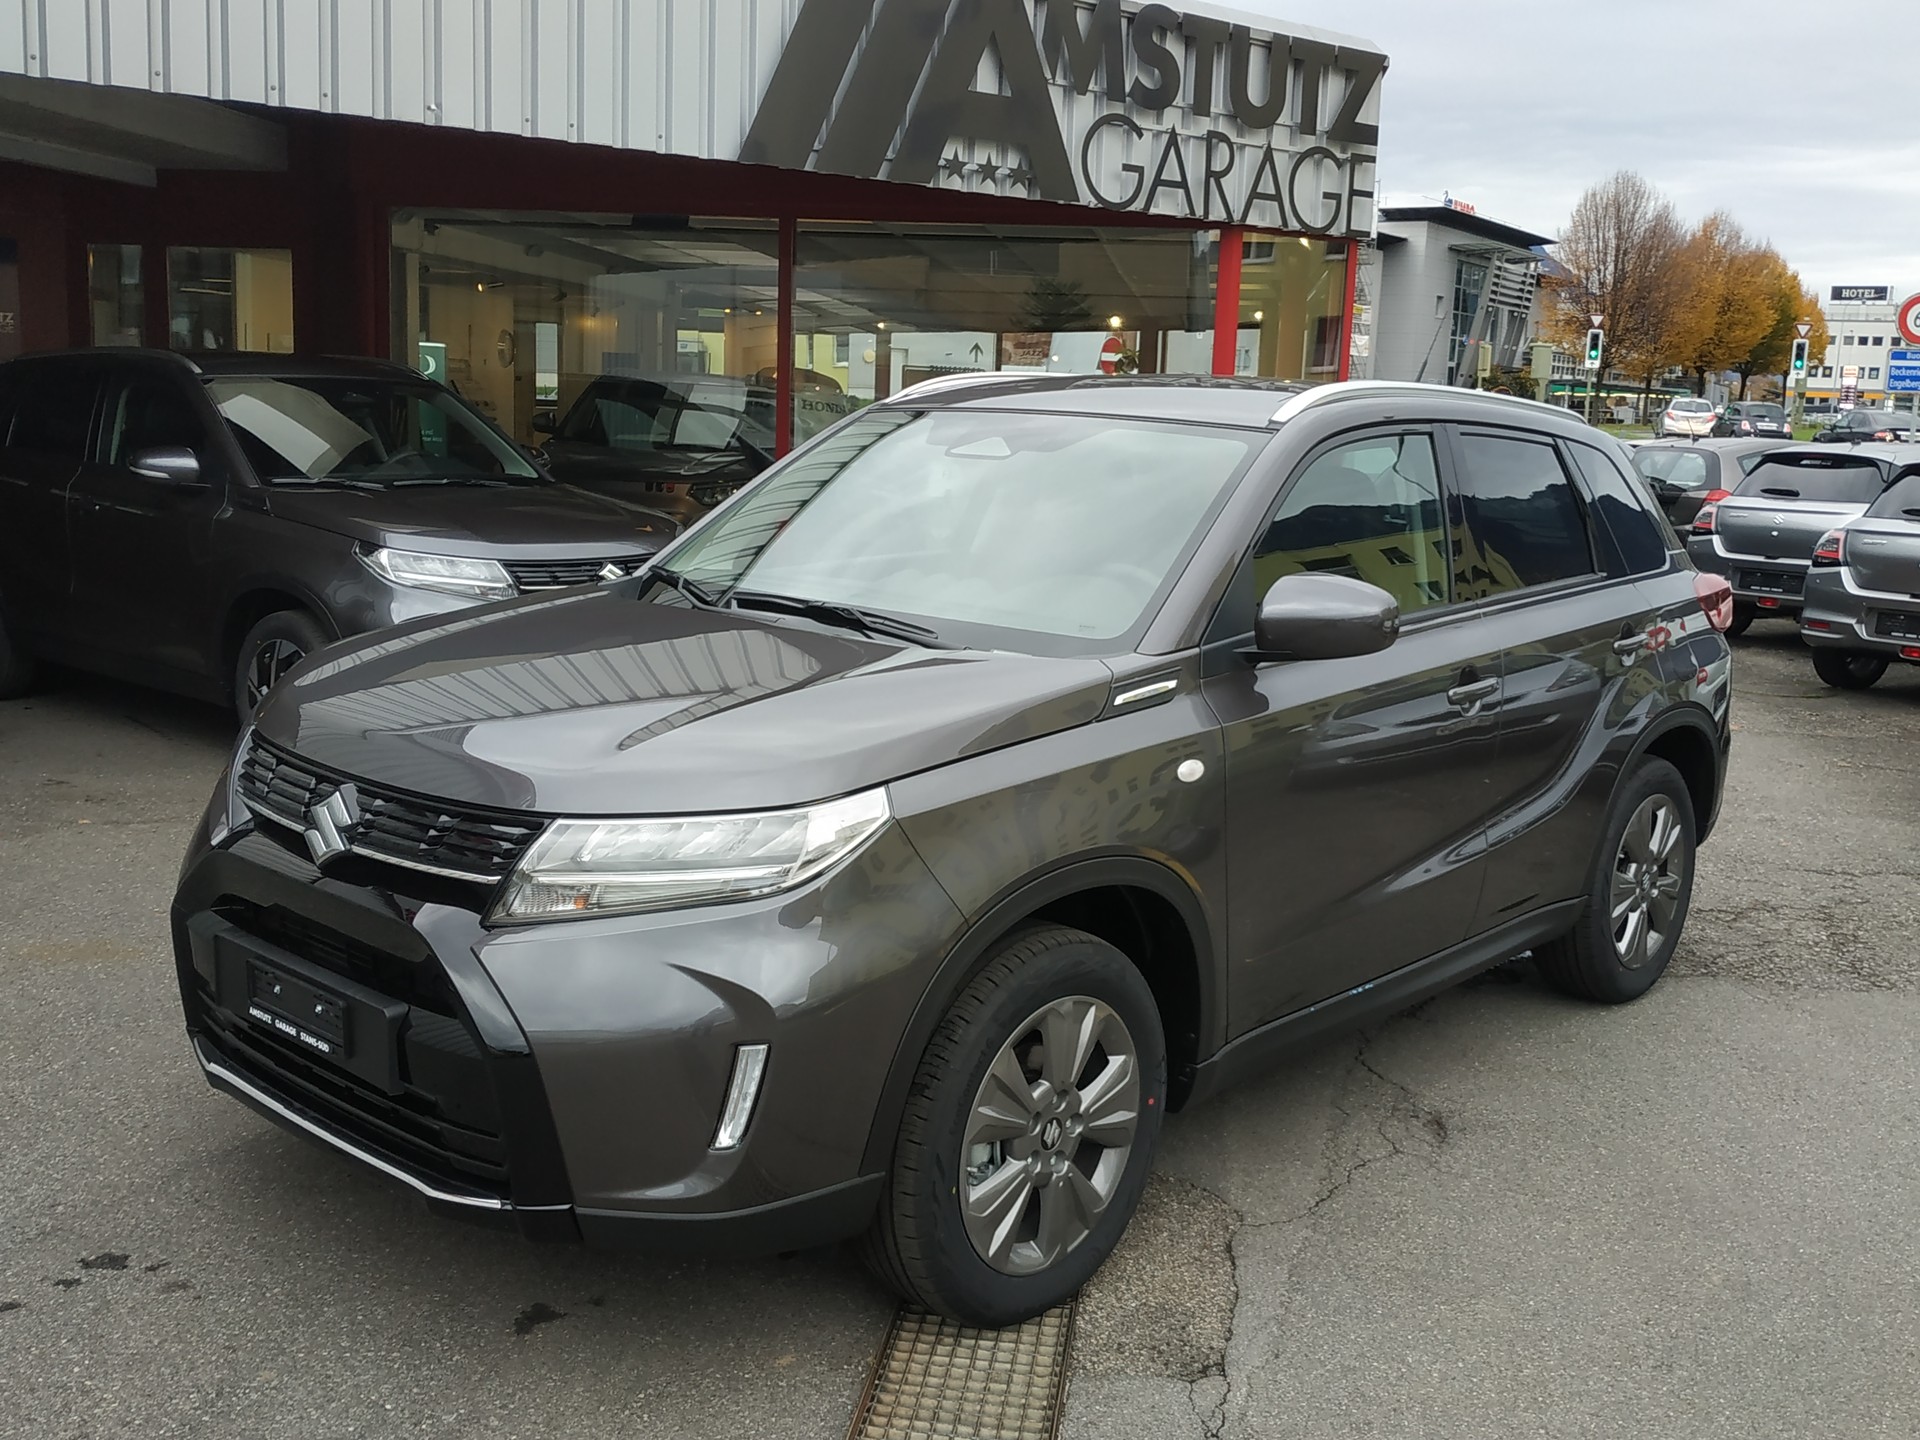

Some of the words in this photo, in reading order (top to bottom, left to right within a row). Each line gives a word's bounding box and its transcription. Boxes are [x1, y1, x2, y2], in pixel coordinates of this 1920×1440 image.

[886, 0, 1388, 203] AMSTUTZ
[1080, 113, 1378, 238] GARAGE
[1841, 288, 1876, 299] HOTEL
[249, 1006, 272, 1024] AMSTUTZ
[275, 1019, 297, 1037] GARAGE
